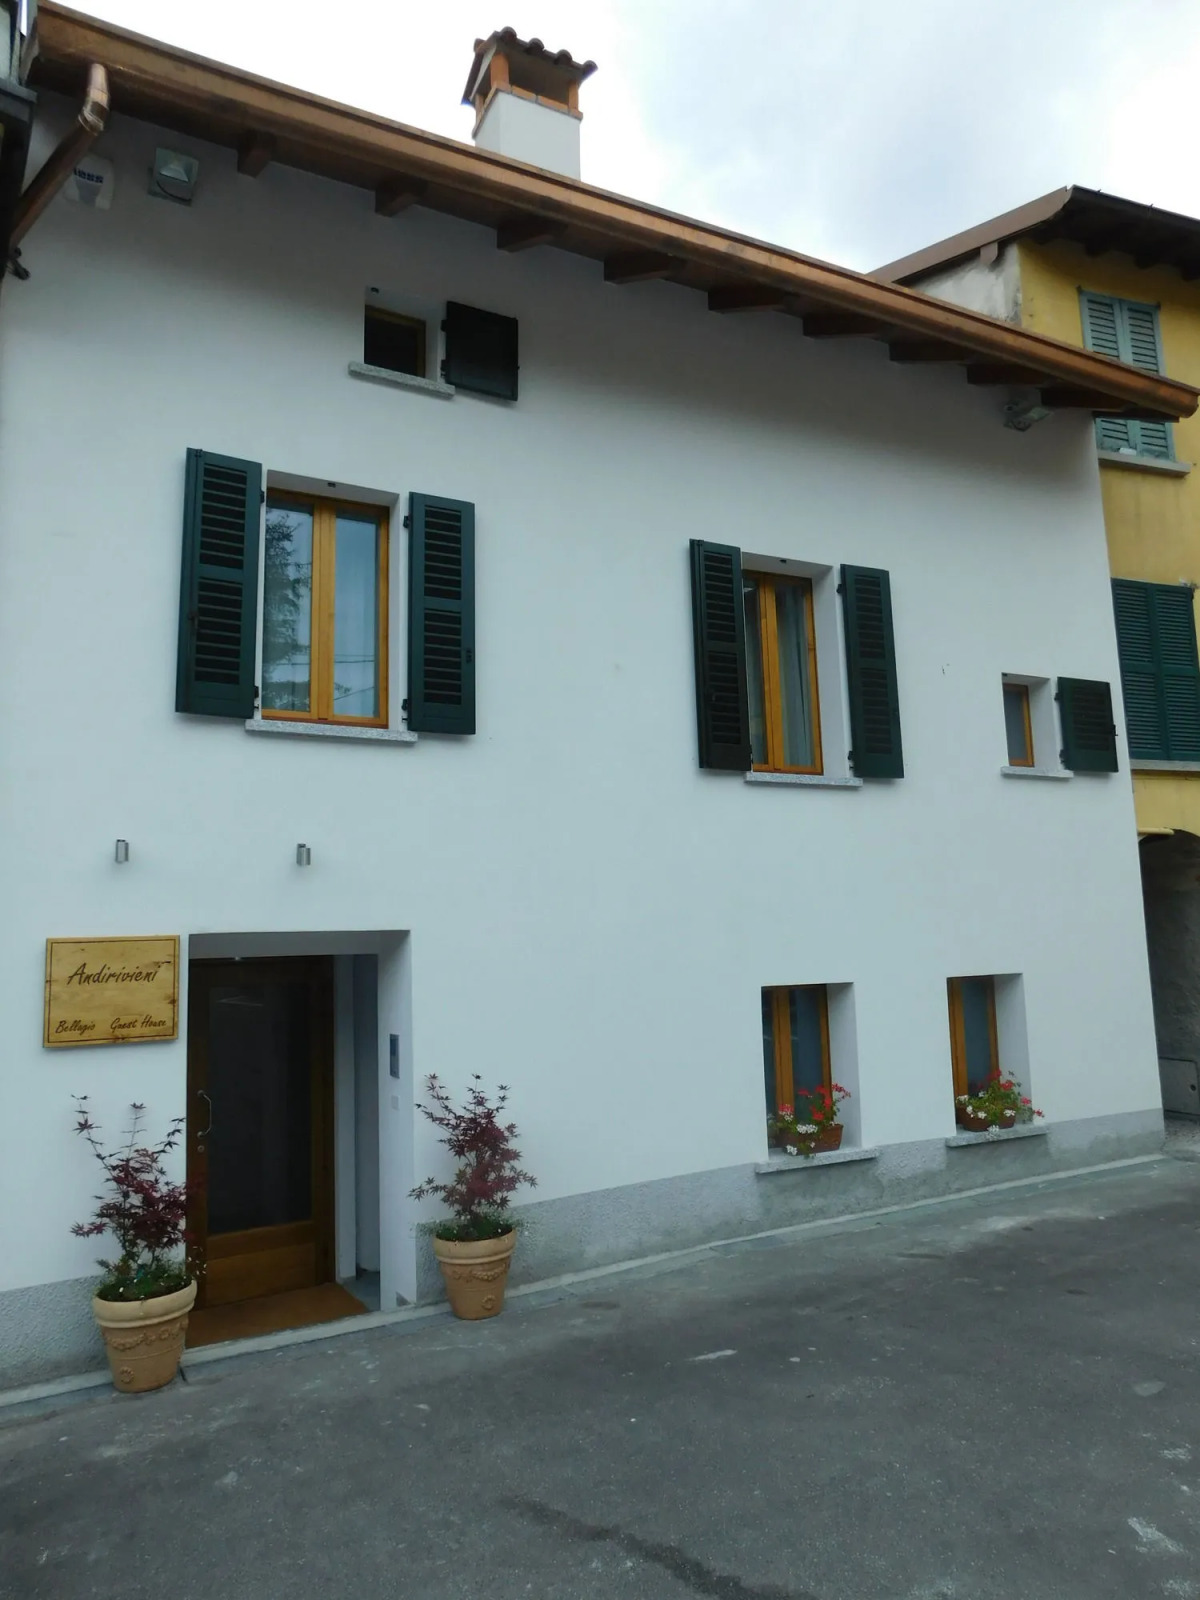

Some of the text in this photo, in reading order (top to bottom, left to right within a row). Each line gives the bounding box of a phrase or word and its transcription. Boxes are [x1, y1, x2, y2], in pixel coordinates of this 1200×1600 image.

[67, 962, 161, 985] Andirivieni
[55, 1014, 167, 1036] Bellagio Guest House
